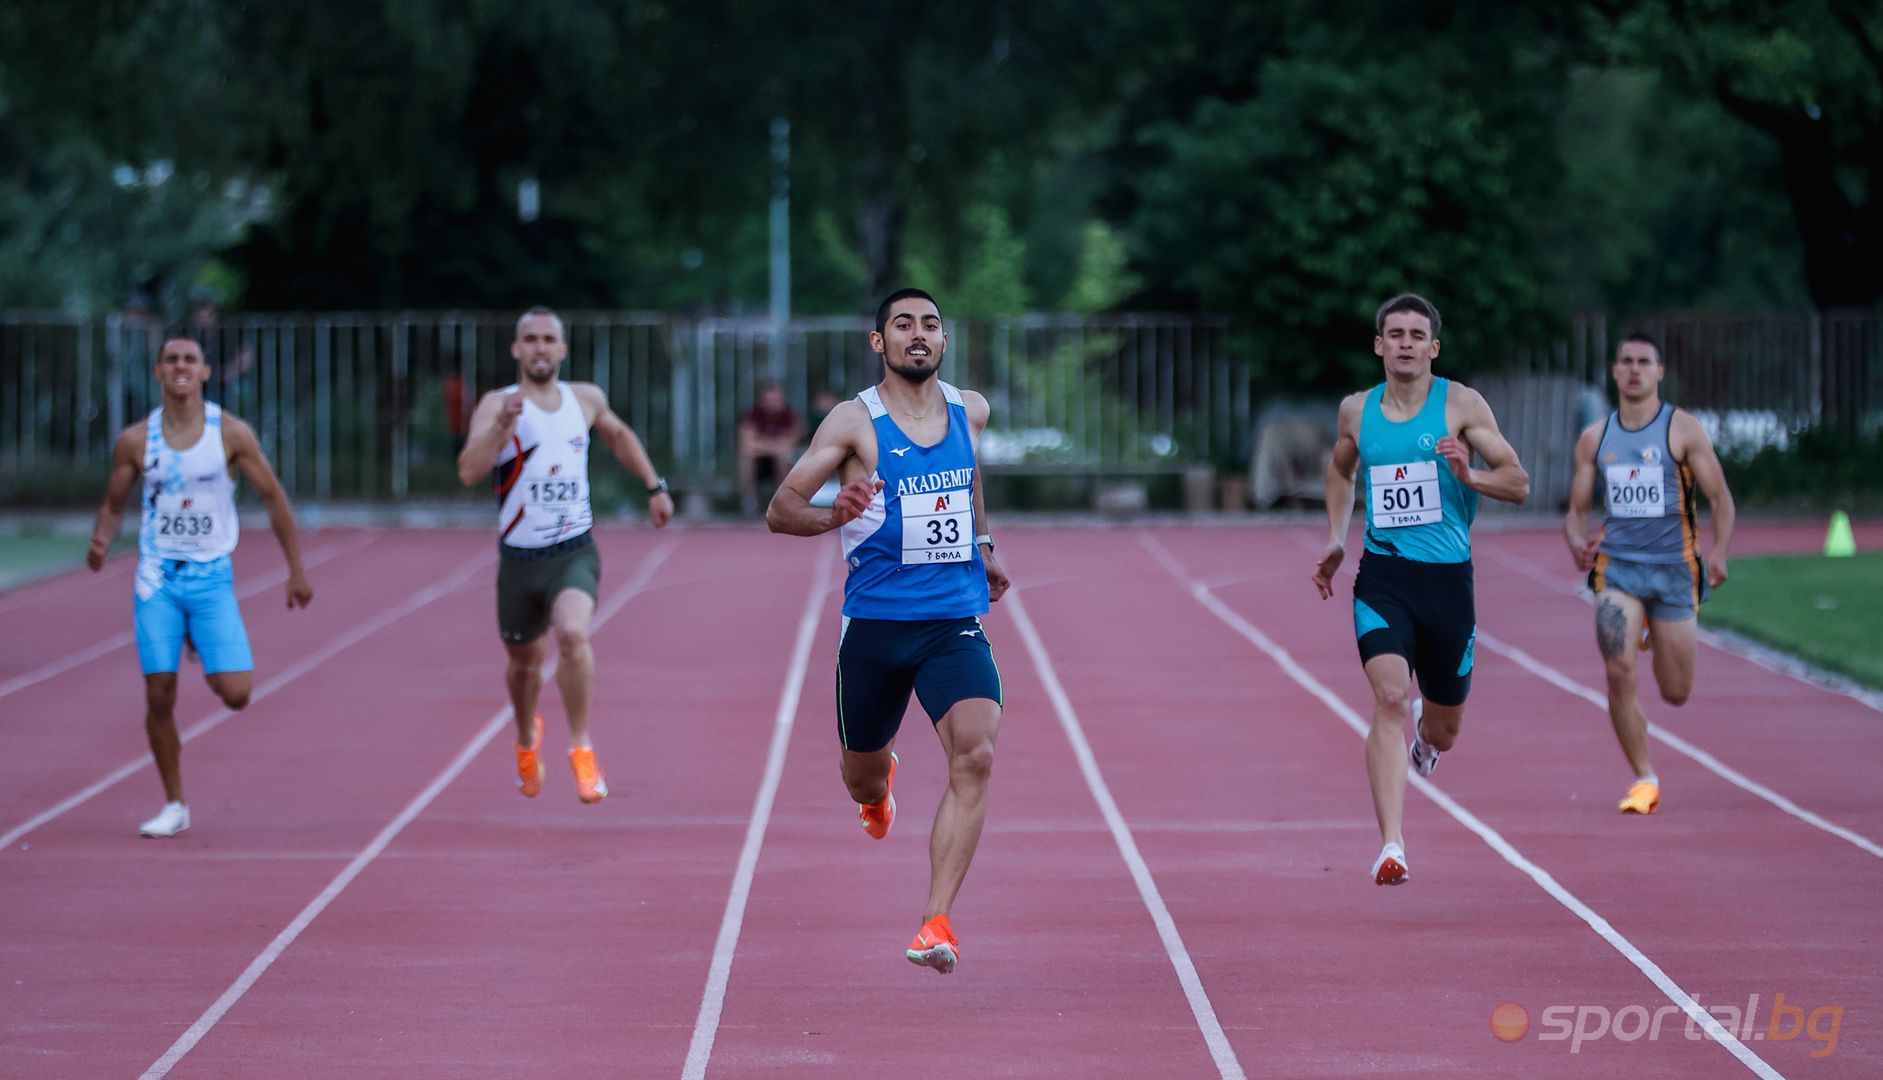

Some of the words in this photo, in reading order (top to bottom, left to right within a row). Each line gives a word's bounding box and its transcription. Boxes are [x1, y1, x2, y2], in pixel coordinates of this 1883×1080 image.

[1394, 465, 1408, 481] A1
[934, 494, 950, 512] A1
[1383, 485, 1425, 511] 501
[1611, 486, 1660, 504] 2006
[159, 515, 213, 536] 2639
[926, 518, 960, 545] 33
[935, 550, 962, 561] БФЛА
